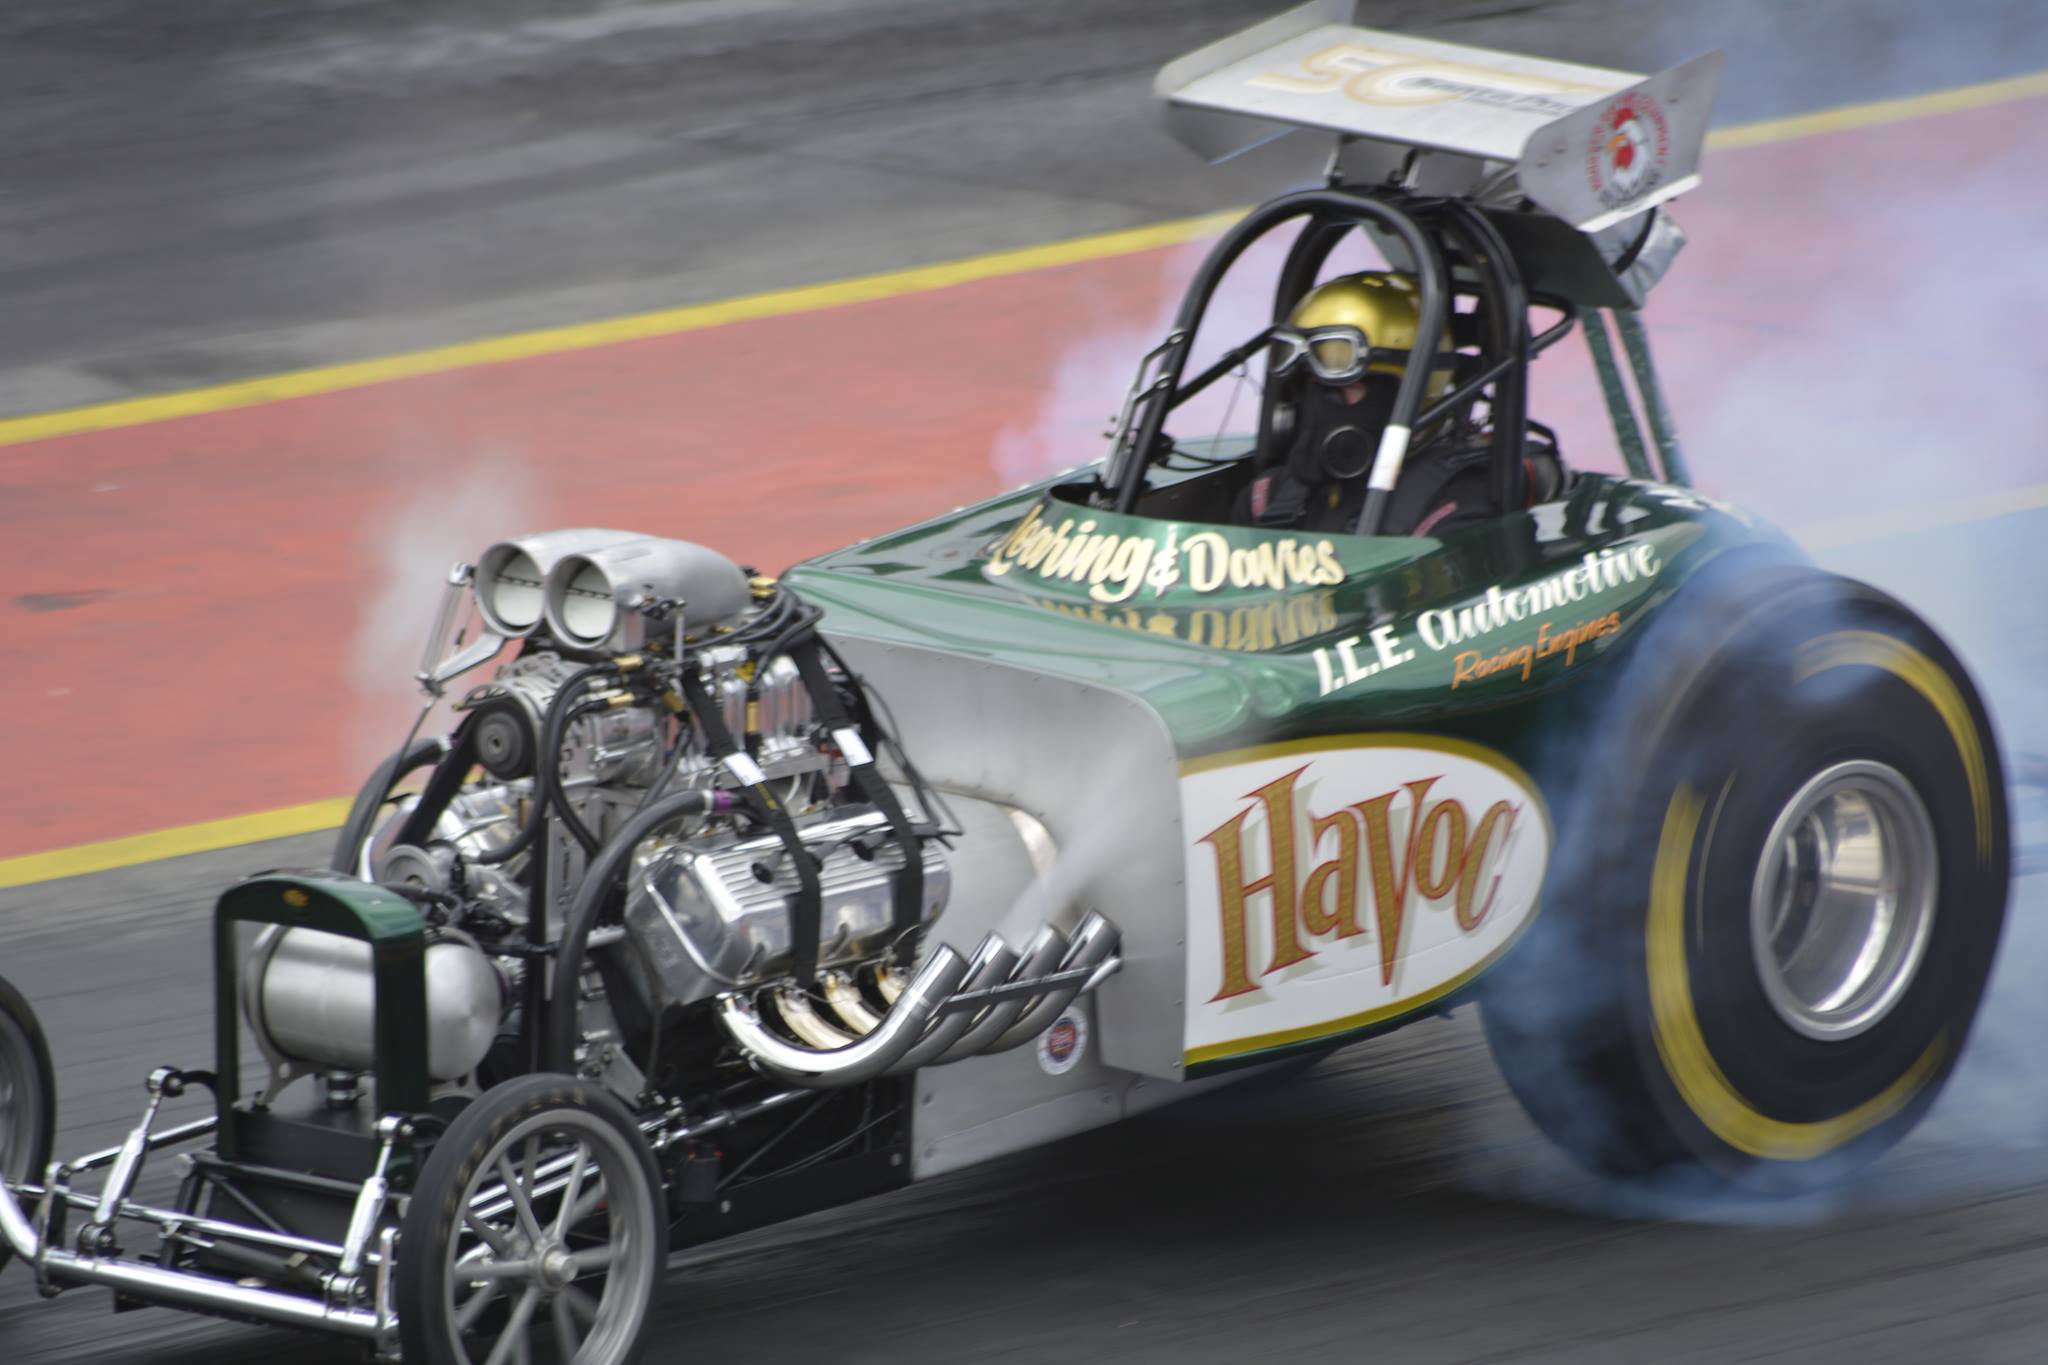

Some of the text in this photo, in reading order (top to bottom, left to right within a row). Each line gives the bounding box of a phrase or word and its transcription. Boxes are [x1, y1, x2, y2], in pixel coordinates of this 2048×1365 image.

[1147, 523, 1181, 597] &
[1182, 532, 1344, 592] Davies
[1416, 543, 1661, 651] Automotive
[1451, 610, 1622, 690] Racing Engines
[1192, 760, 1524, 1005] Havoc
